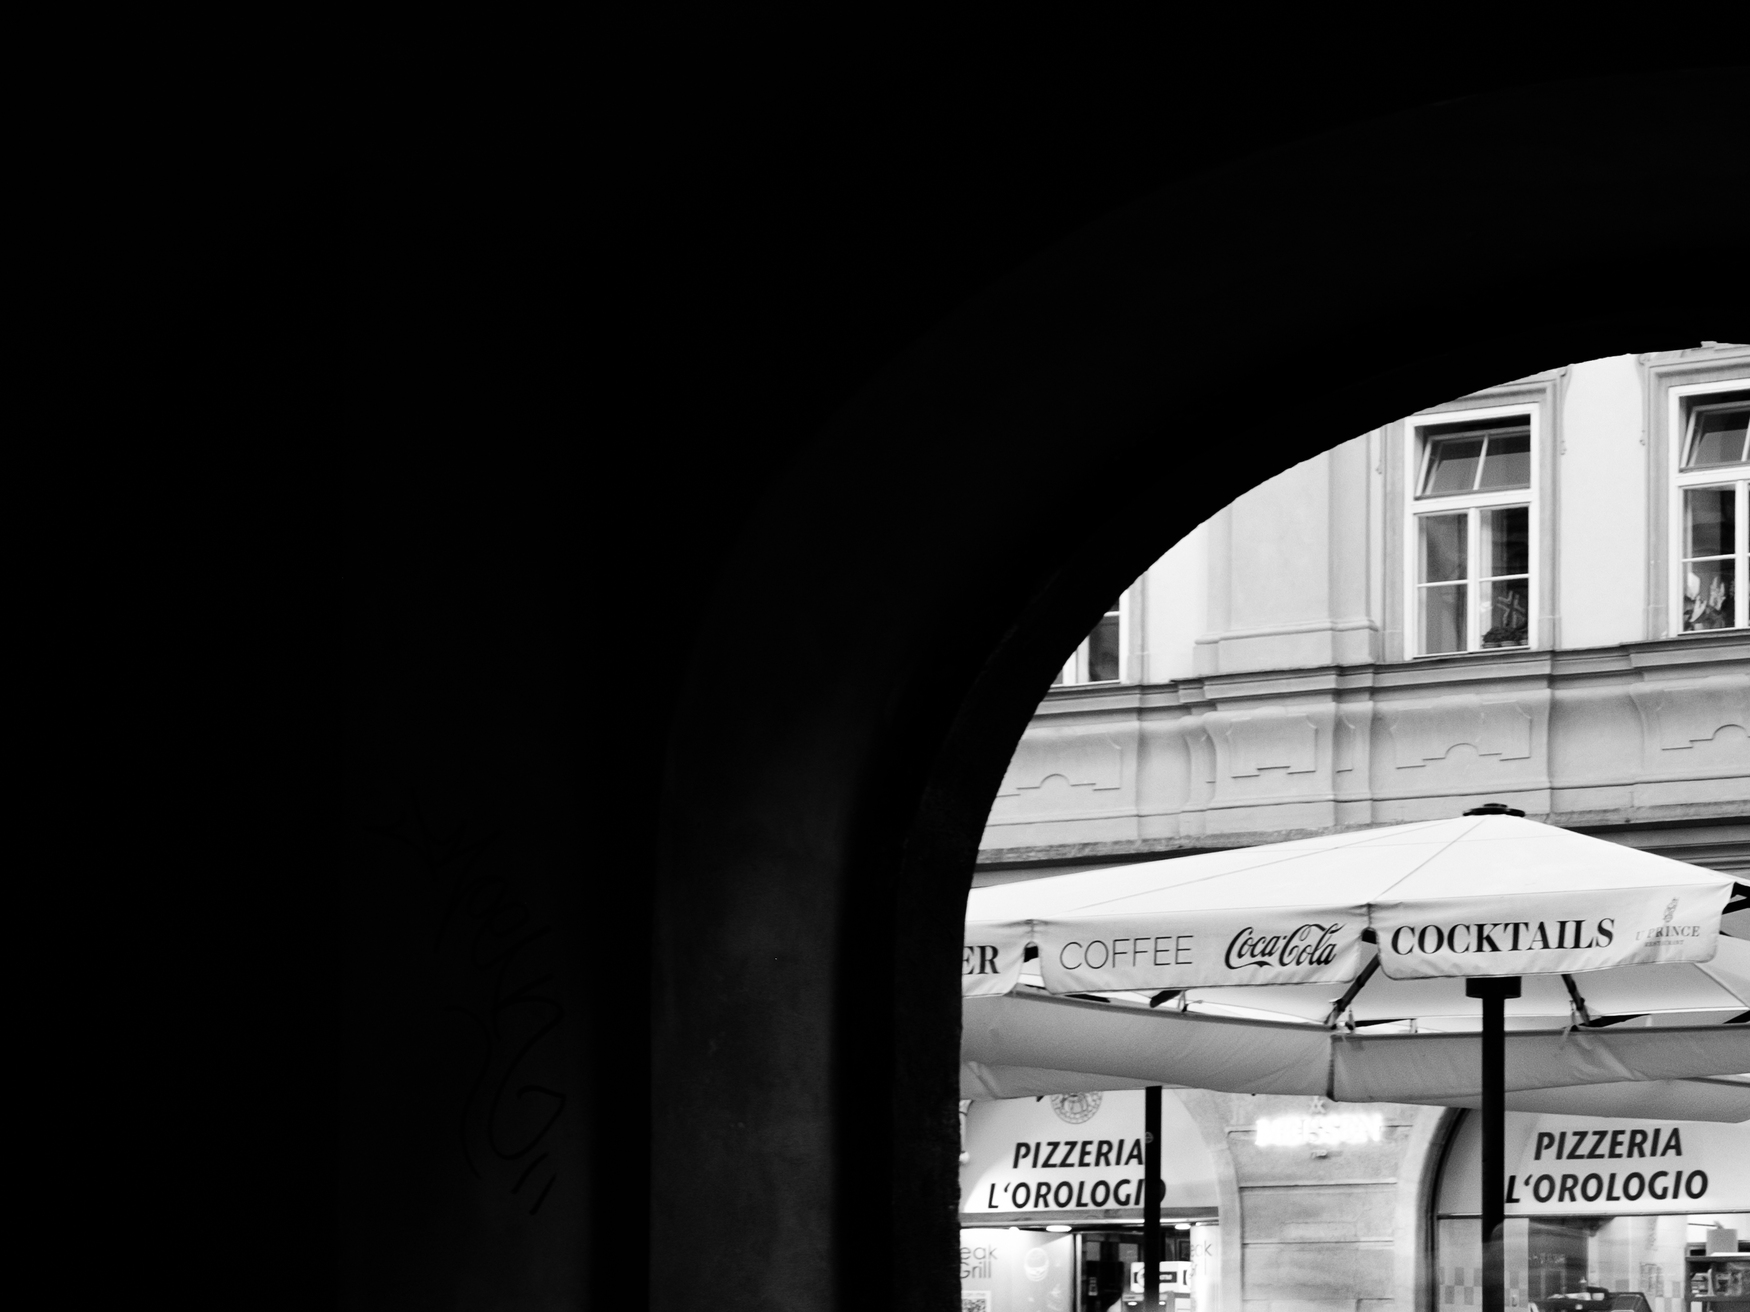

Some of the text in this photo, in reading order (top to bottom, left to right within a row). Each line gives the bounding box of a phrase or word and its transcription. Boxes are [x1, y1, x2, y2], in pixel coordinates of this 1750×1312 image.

[1060, 934, 1194, 970] COFFEE
[1225, 922, 1347, 970] Coca-Cola
[1391, 917, 1615, 956] COCKTAILS
[1012, 1138, 1144, 1169] PIZZERIA
[1534, 1127, 1683, 1161] PIZZERIA
[1505, 1169, 1709, 1204] L'OROLOGIO
